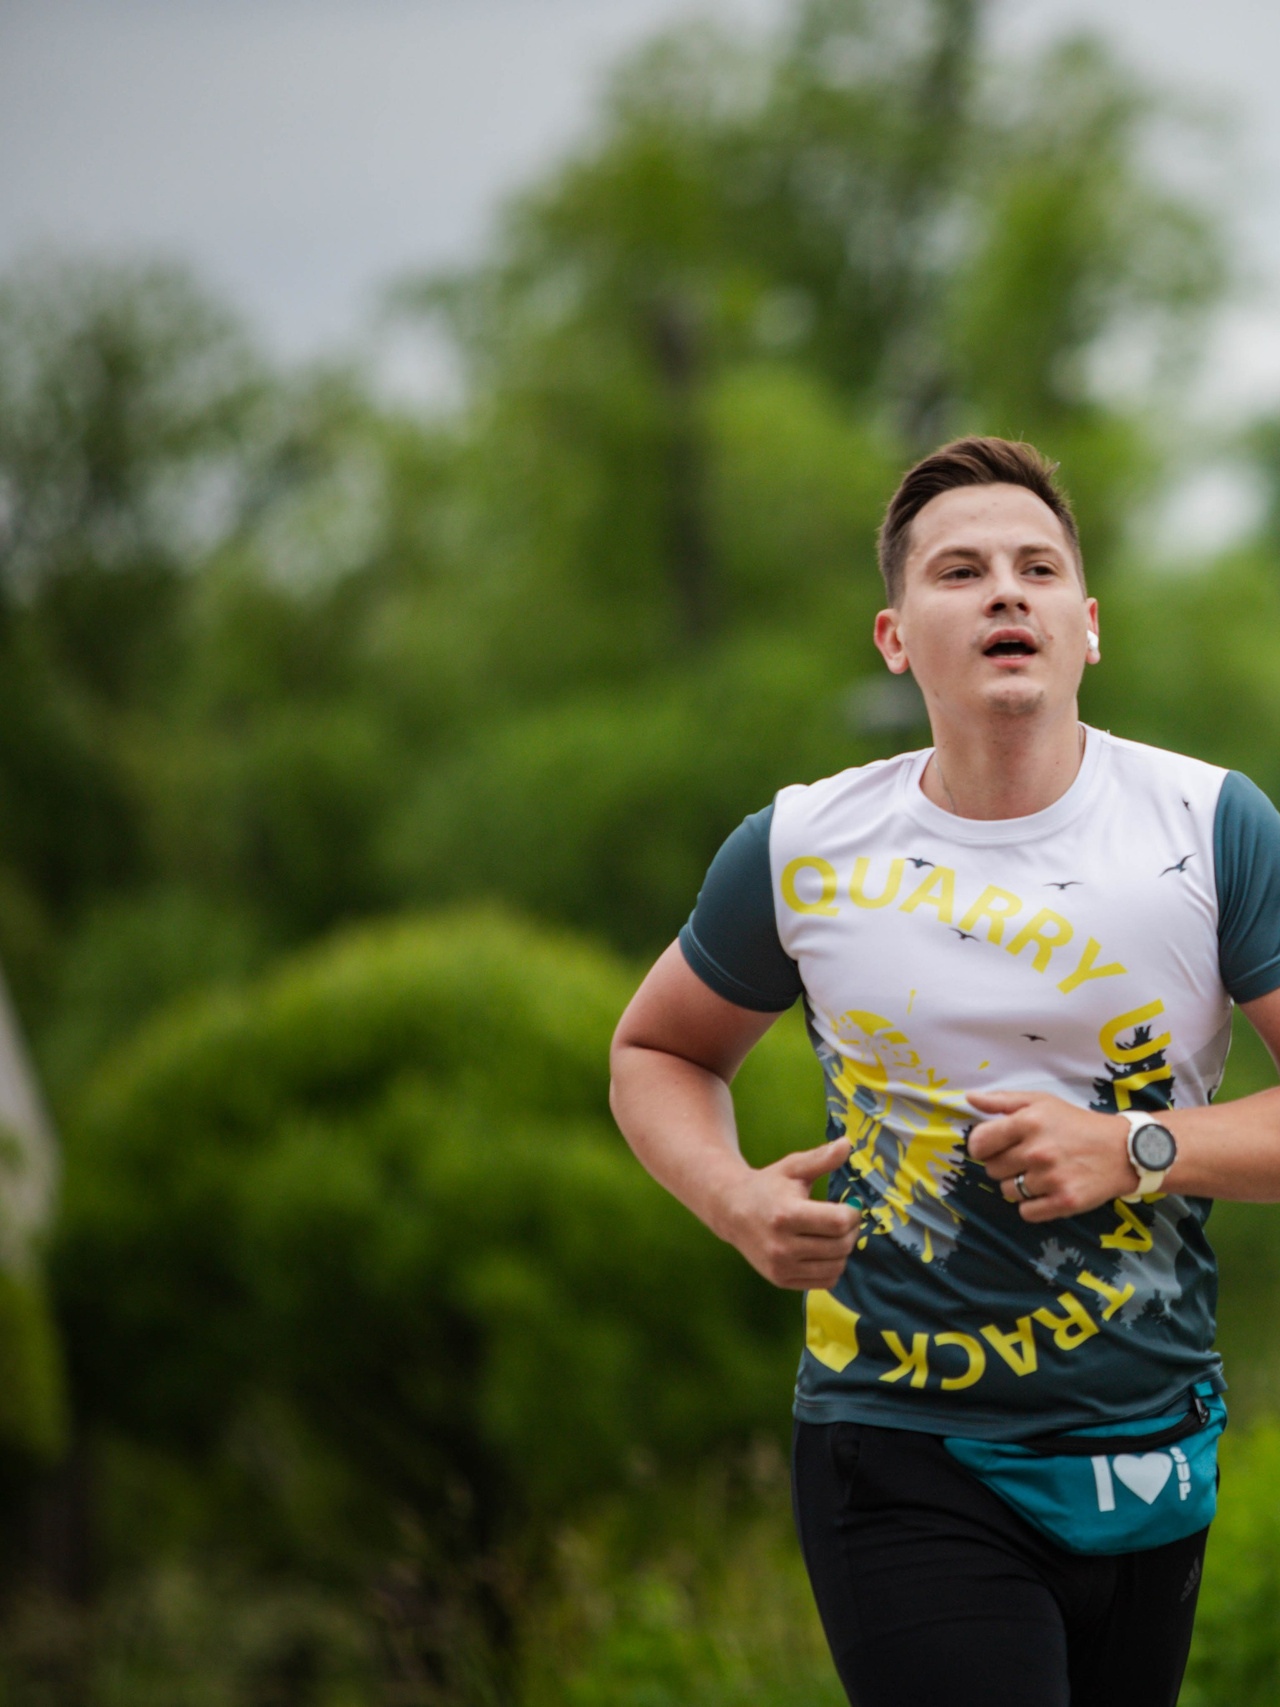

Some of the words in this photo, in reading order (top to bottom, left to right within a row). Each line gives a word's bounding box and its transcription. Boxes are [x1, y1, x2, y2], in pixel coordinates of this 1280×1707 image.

[780, 856, 1128, 996] QUARRY
[1099, 998, 1172, 1252] ULA
[878, 1270, 1136, 1390] TRACK
